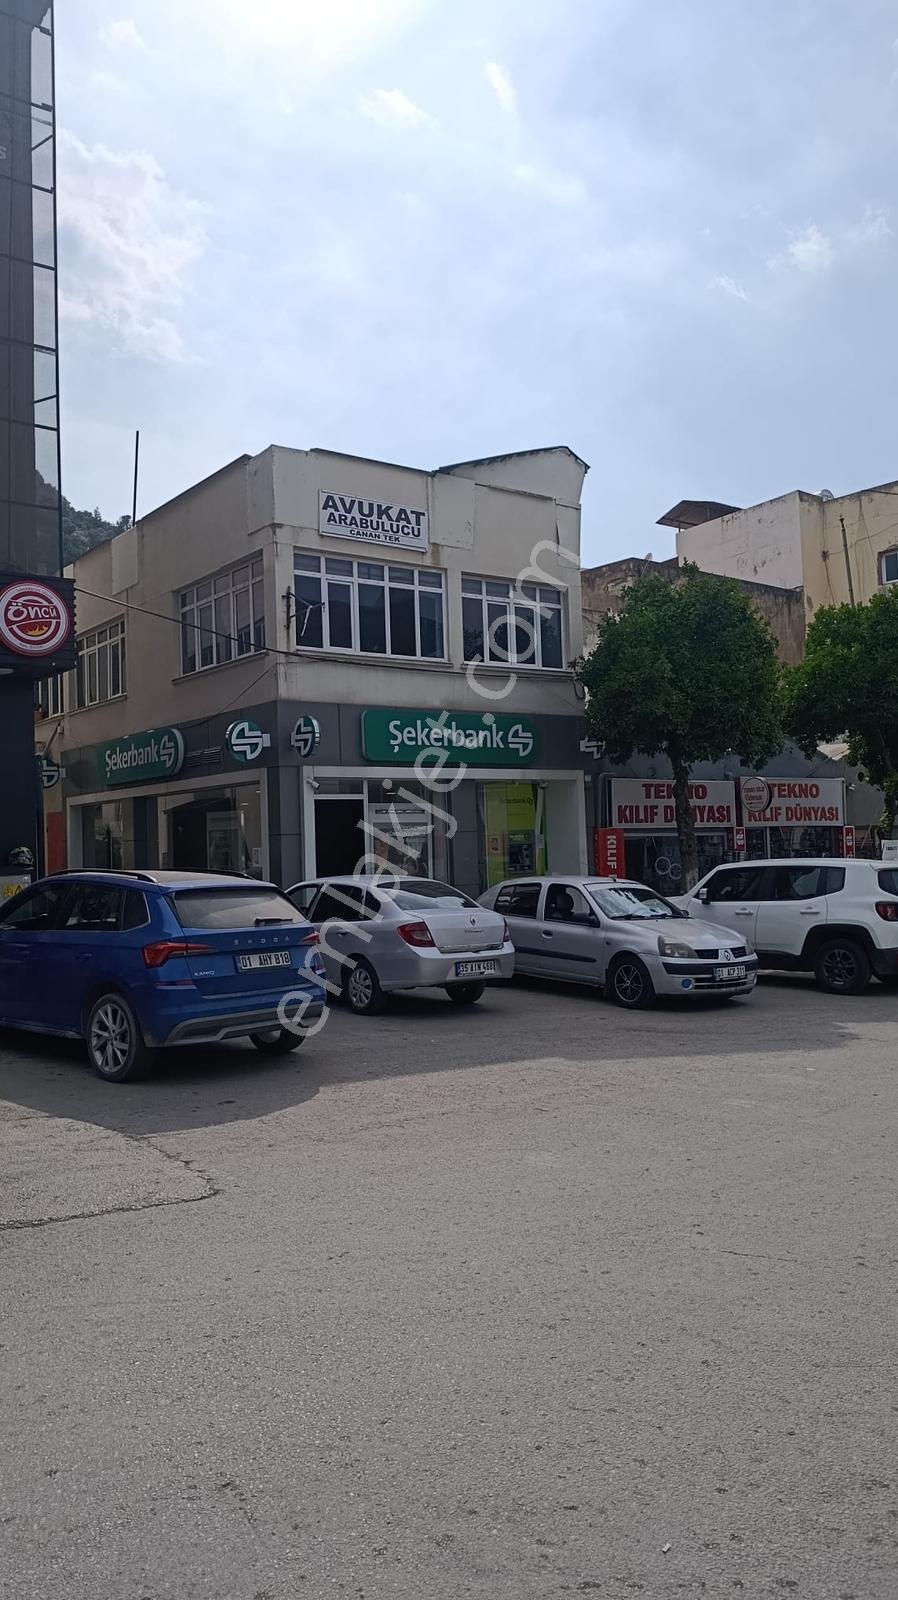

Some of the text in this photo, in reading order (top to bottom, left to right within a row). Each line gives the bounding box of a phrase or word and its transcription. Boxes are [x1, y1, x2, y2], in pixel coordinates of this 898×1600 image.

[322, 495, 425, 526] AVUKAT
[326, 512, 421, 538] ARABULUCU
[349, 529, 401, 543] CANAN TEK
[7, 602, 57, 621] Öncü
[388, 719, 505, 753] Şekerbank
[105, 738, 159, 778] Şekerbank
[767, 783, 820, 799] TEKNO
[617, 804, 658, 824] KILIF
[663, 804, 731, 823] DYASI
[748, 803, 839, 822] KILIF DÜNYASI
[607, 835, 617, 869] KILIF
[241, 952, 290, 968] 01 AHY 818
